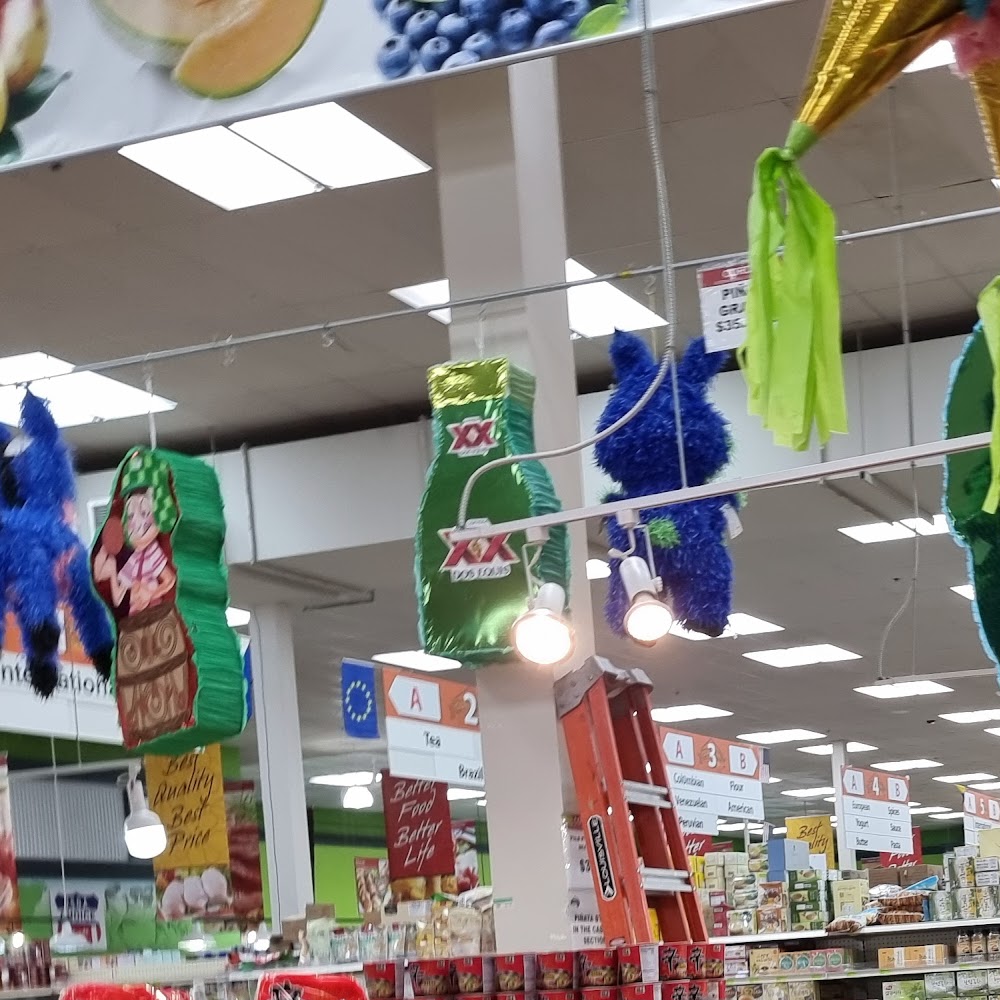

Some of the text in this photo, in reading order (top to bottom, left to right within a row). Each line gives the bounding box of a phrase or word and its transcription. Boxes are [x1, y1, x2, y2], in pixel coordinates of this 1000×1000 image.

[410, 686, 422, 712] A
[463, 692, 480, 726] 2
[423, 731, 442, 749] Tea
[675, 740, 684, 760] A
[707, 742, 717, 768] 3
[740, 752, 747, 770] B
[851, 775, 858, 791] A
[872, 777, 880, 796] 4
[168, 796, 208, 829] Best
[398, 799, 436, 824] Food
[980, 797, 986, 811] 5
[168, 827, 211, 856] Price
[394, 820, 443, 849] Better
[796, 821, 823, 840] Best
[404, 844, 435, 873] Life
